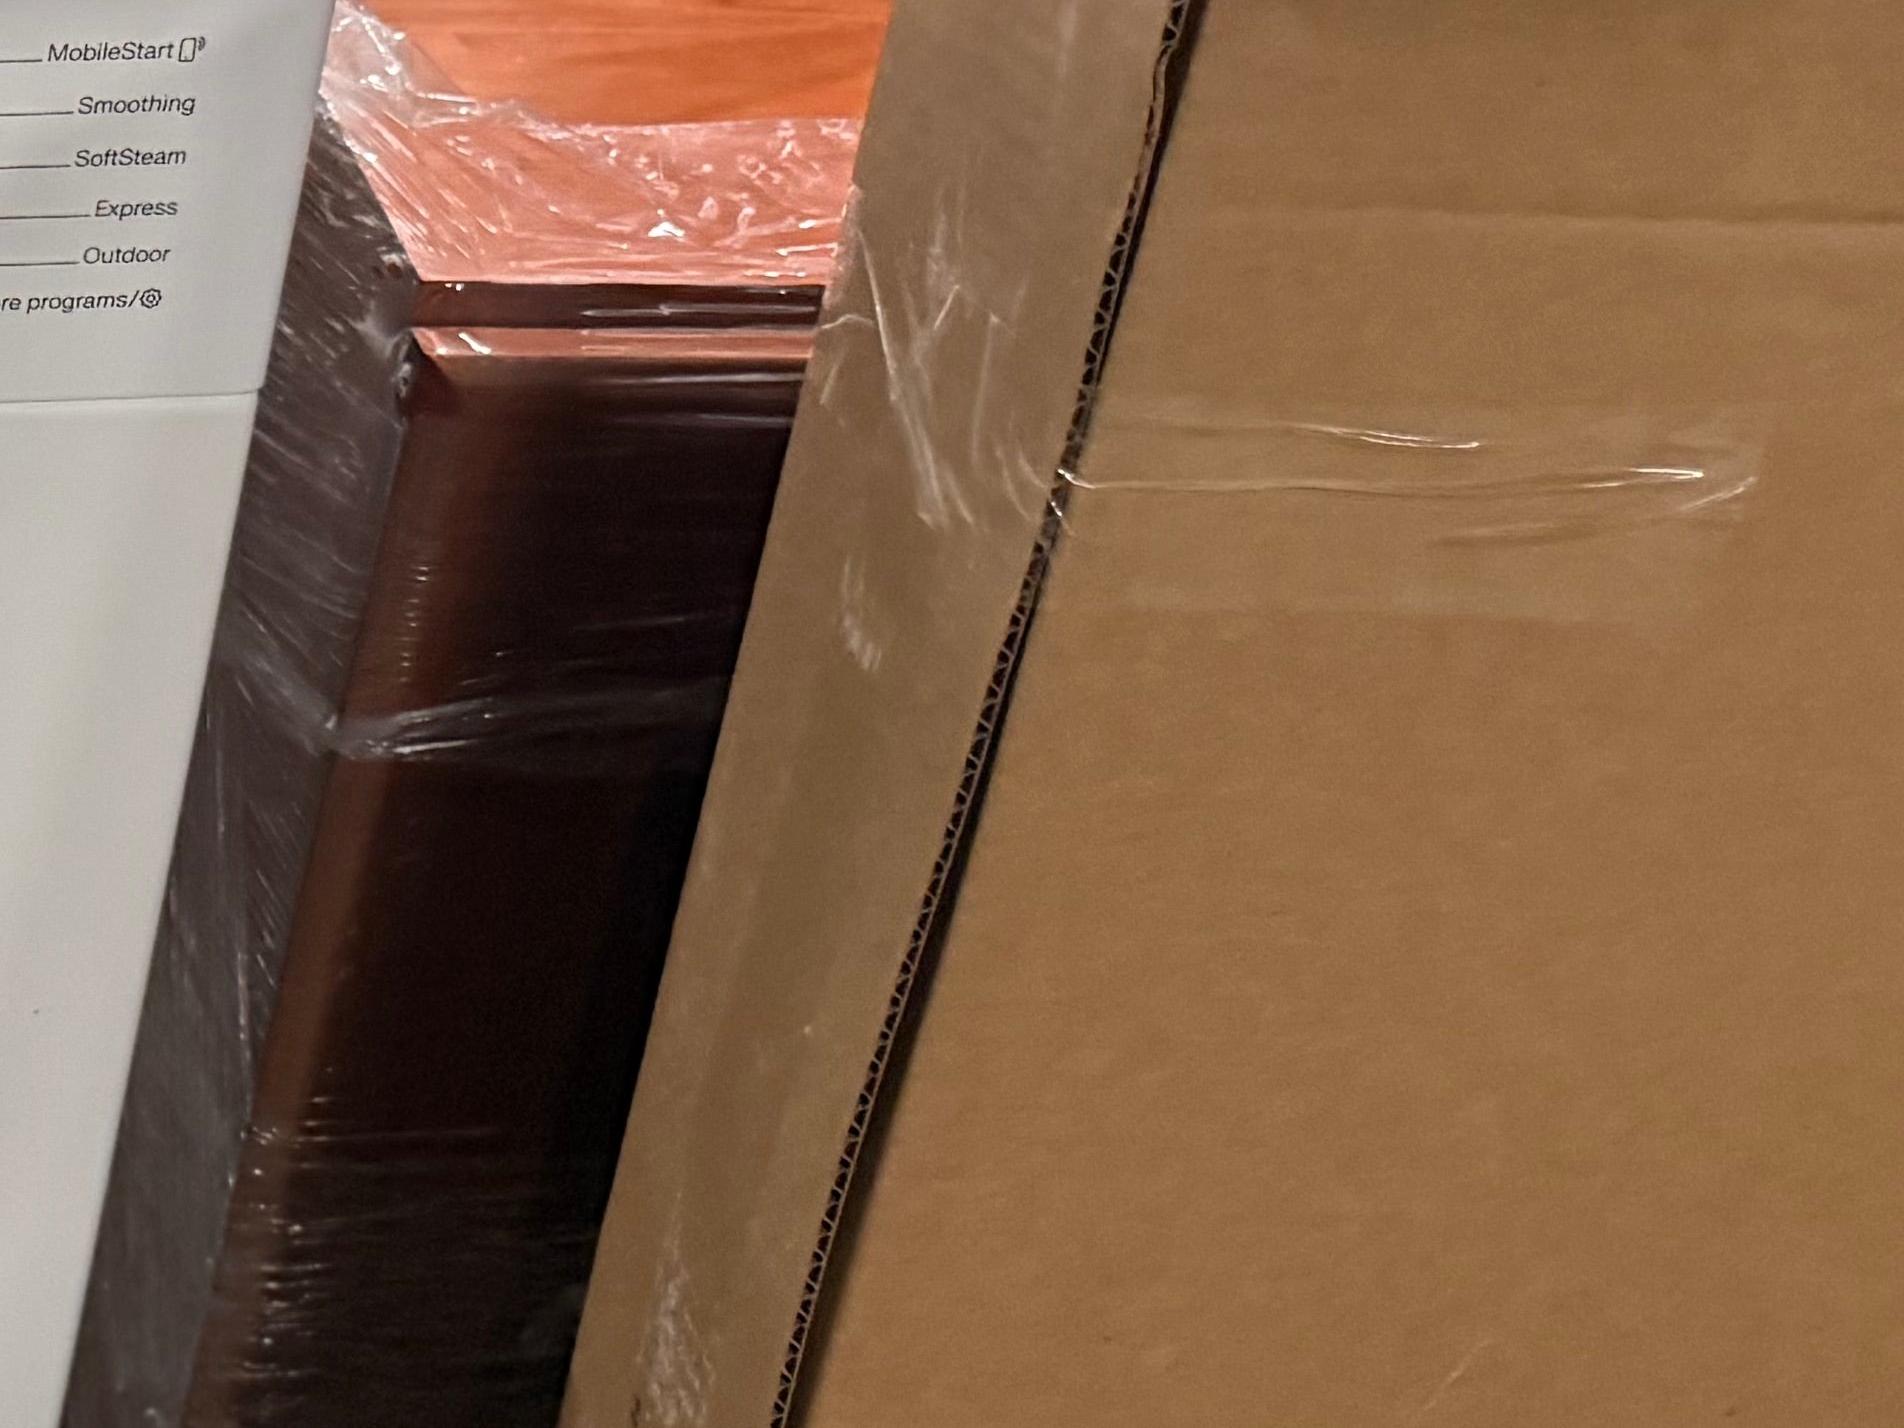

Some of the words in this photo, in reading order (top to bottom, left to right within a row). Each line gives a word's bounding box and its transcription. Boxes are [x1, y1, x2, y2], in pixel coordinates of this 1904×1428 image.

[47, 41, 175, 62] MobileStart
[77, 95, 196, 116] Smoothing
[74, 148, 187, 167] SoftSteam
[95, 200, 178, 221] Express
[83, 247, 171, 265] Outdoor
